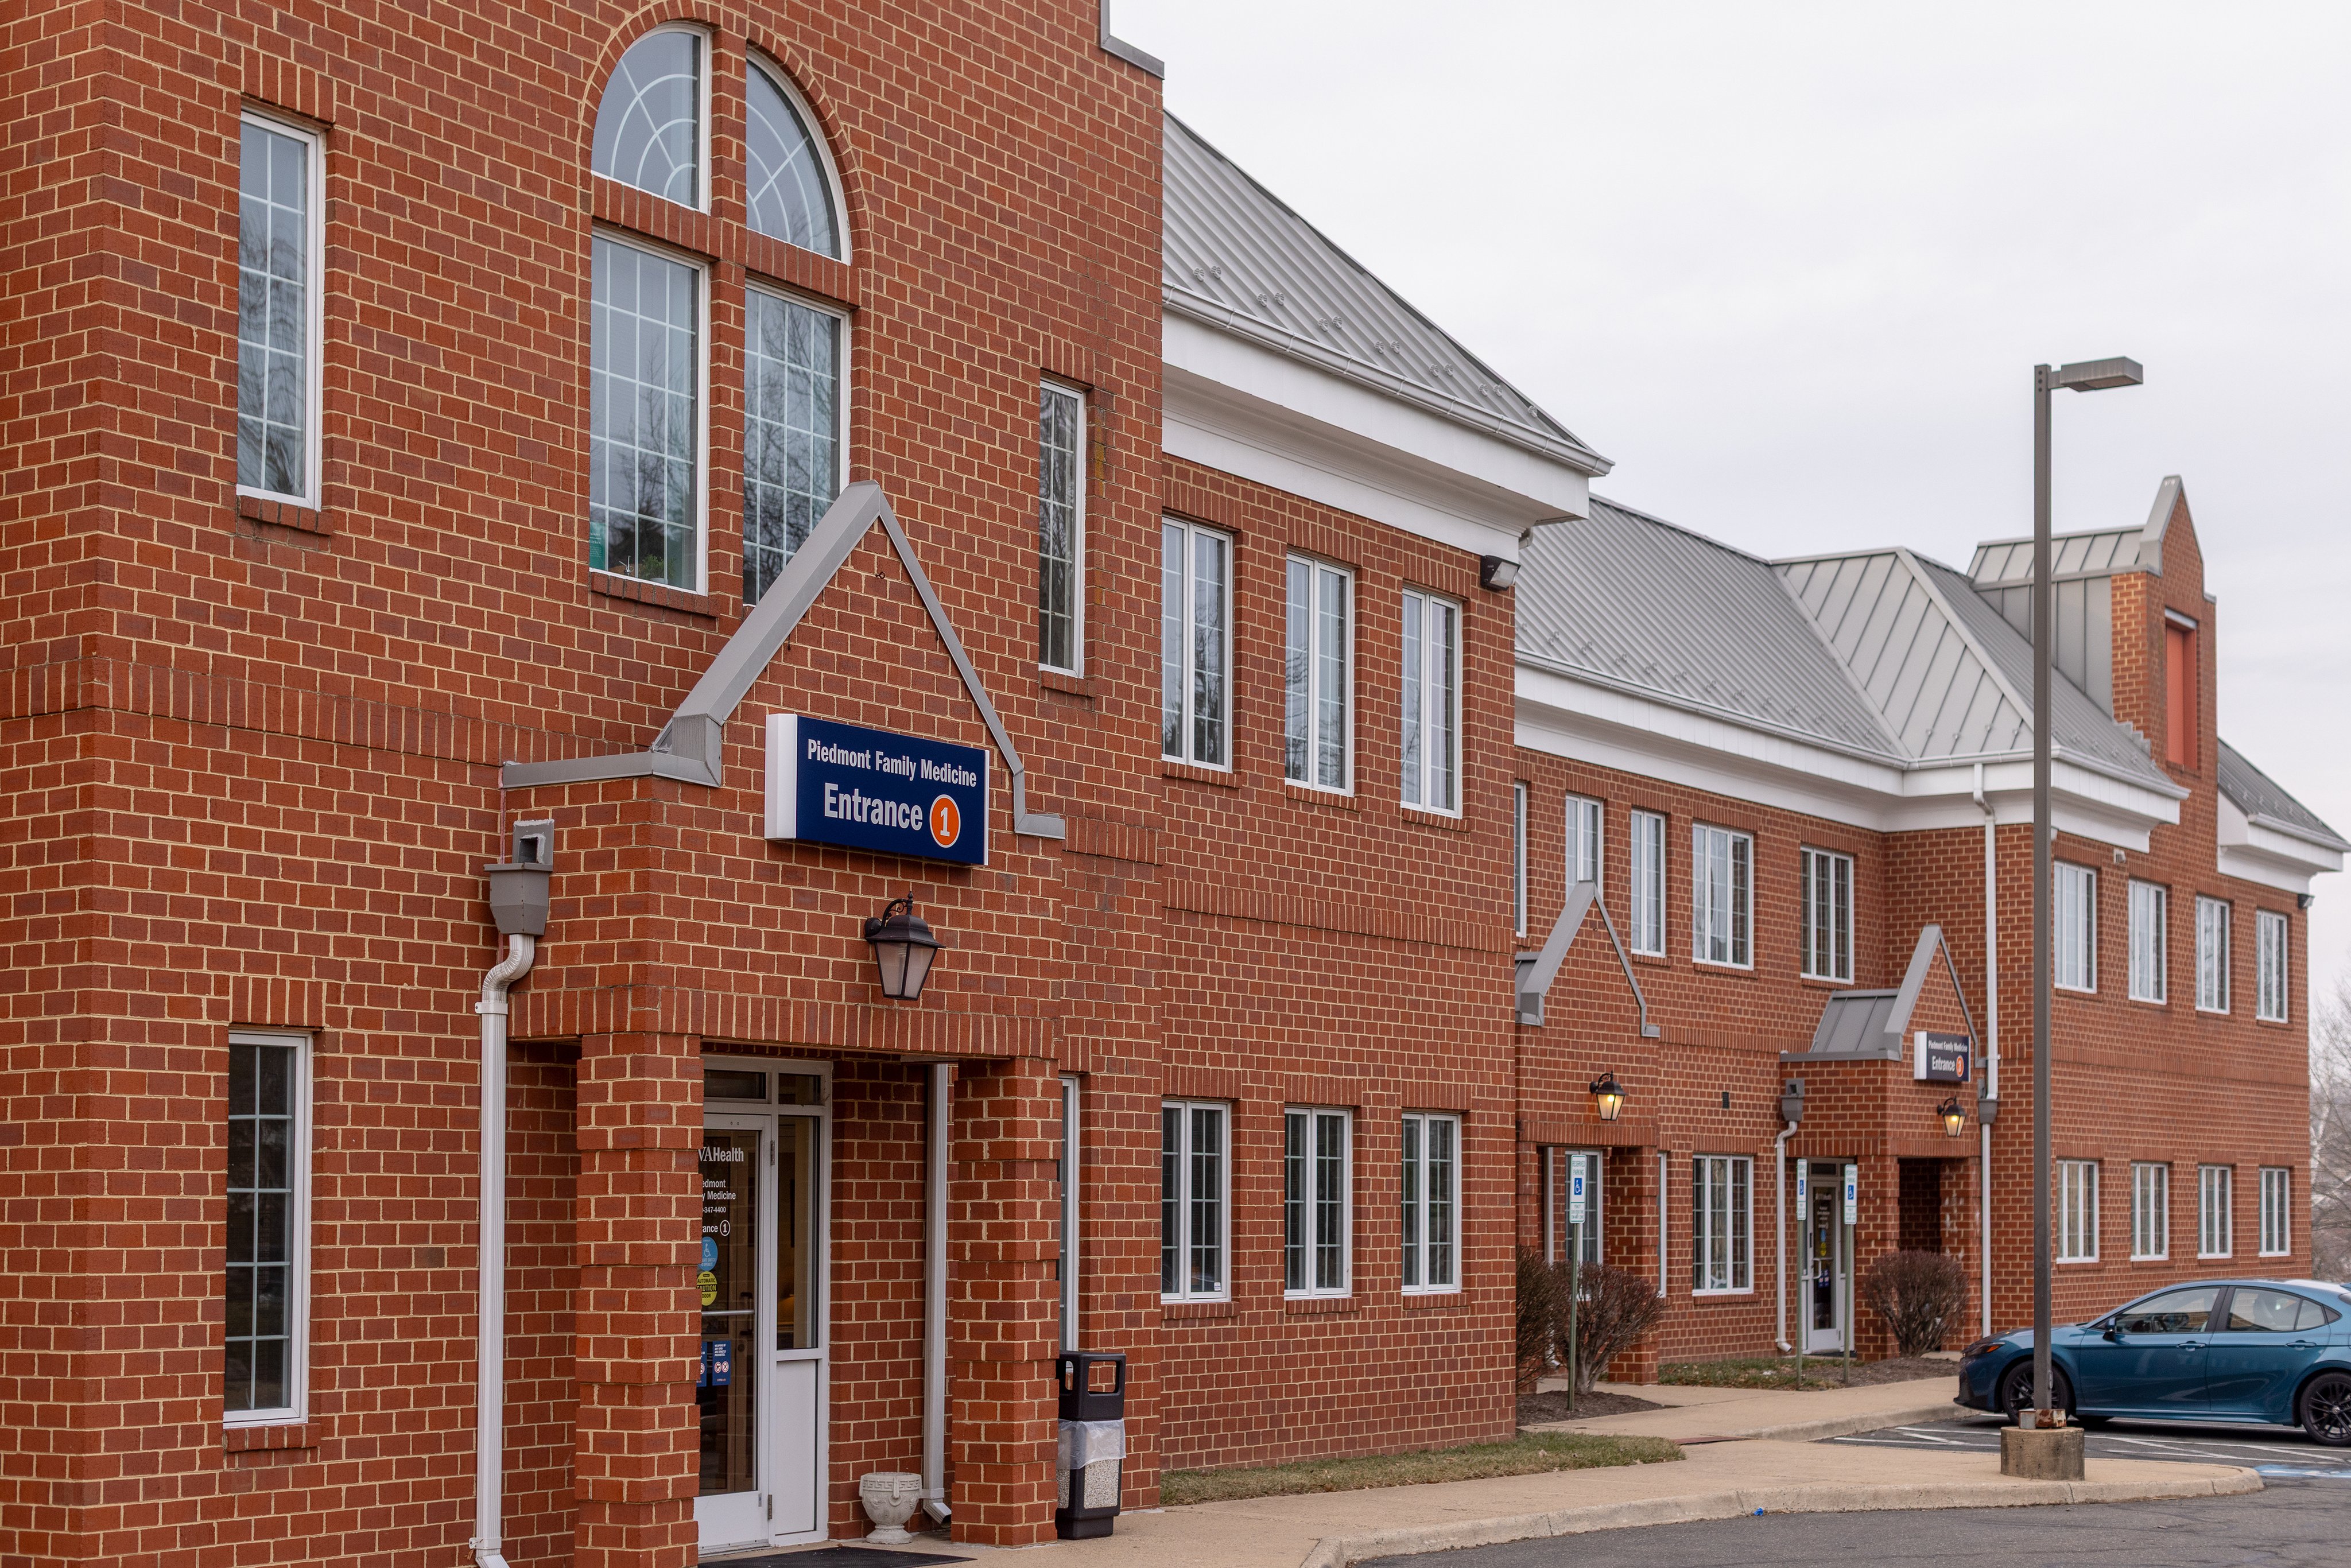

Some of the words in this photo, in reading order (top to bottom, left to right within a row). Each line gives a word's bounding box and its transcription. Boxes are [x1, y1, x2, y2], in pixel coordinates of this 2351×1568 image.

[808, 739, 871, 770] Piedmont
[875, 751, 917, 781] Family
[921, 759, 977, 787] Medicine
[824, 782, 923, 830] Entrance
[940, 807, 950, 837] 1
[1929, 1039, 1943, 1050] Piedmont
[1943, 1041, 1953, 1053] Family
[1954, 1042, 1968, 1053] Medicine
[1932, 1055, 1956, 1072] Entrance
[698, 1146, 744, 1162] VAHealth
[703, 1179, 726, 1187] edmont
[707, 1191, 736, 1200] Medicine
[723, 1223, 727, 1232] 1
